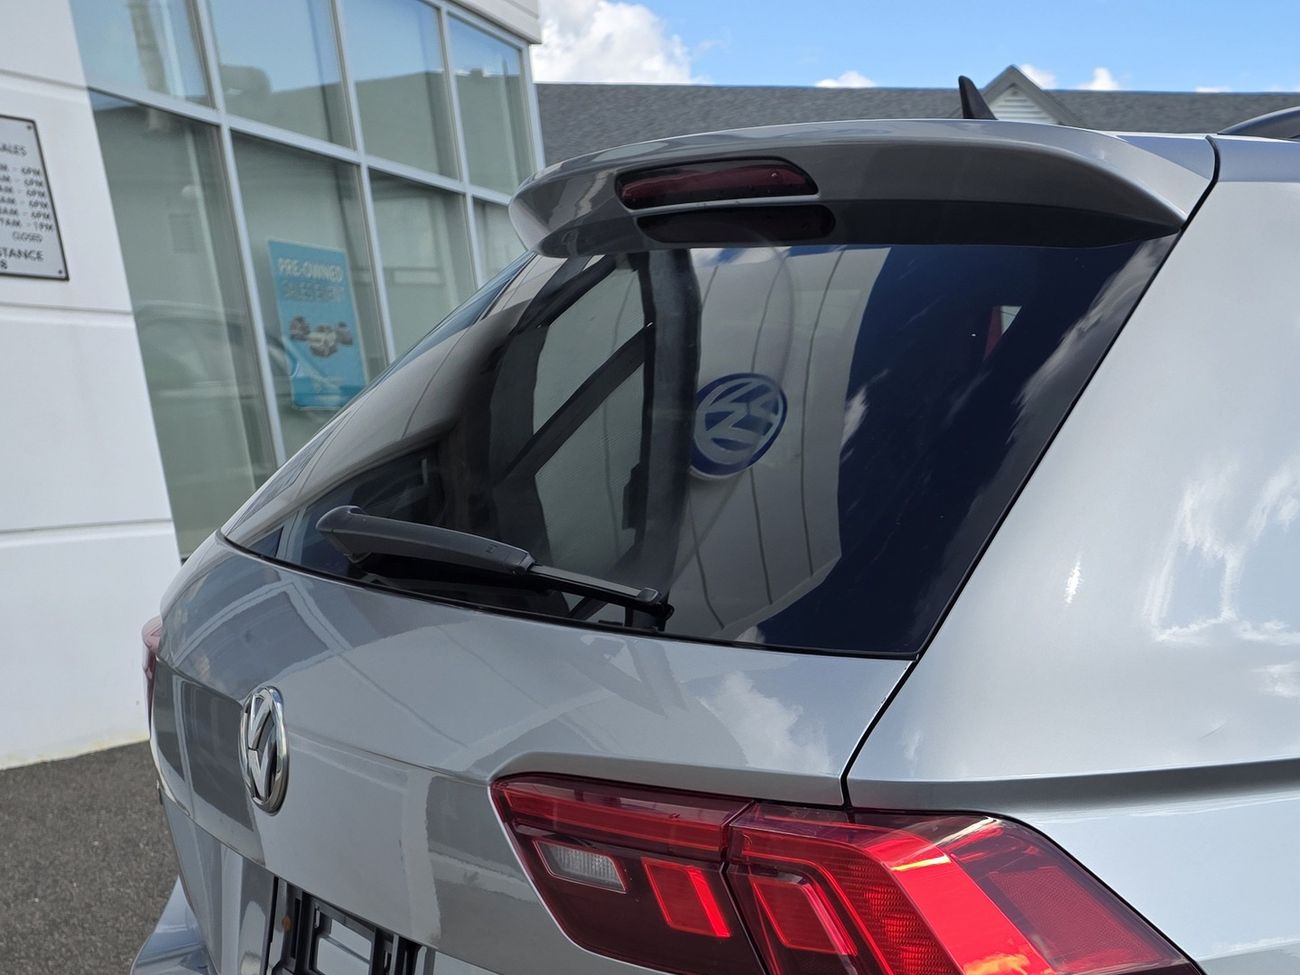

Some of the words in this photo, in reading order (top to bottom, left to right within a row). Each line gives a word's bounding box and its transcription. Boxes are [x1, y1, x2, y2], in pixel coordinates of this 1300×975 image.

[0, 143, 27, 157] ALES
[12, 231, 43, 243] CLOSED
[278, 258, 343, 282] PRE-OWNED
